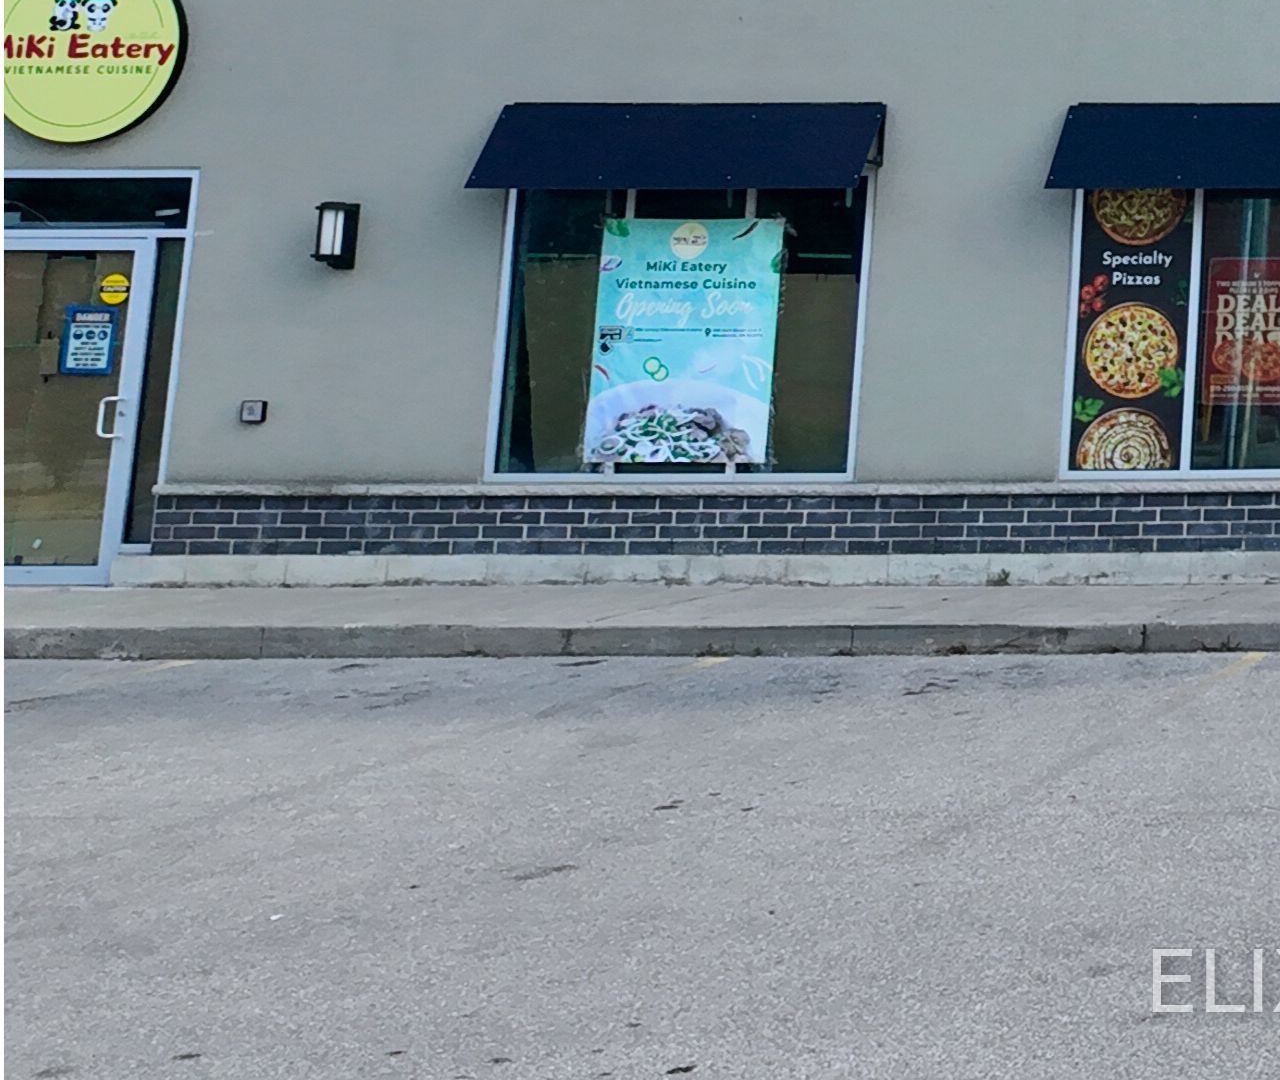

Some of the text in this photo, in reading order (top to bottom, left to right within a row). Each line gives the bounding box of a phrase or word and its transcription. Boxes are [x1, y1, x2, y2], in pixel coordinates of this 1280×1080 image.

[67, 33, 175, 66] Eatery
[97, 65, 152, 75] CUISINE
[1102, 249, 1173, 268] Specialty
[646, 260, 728, 274] MiKi Eatery
[616, 278, 757, 290] Vietnamese Cuisine
[1112, 271, 1161, 285] Pizzas
[616, 291, 754, 327] Opening Soon
